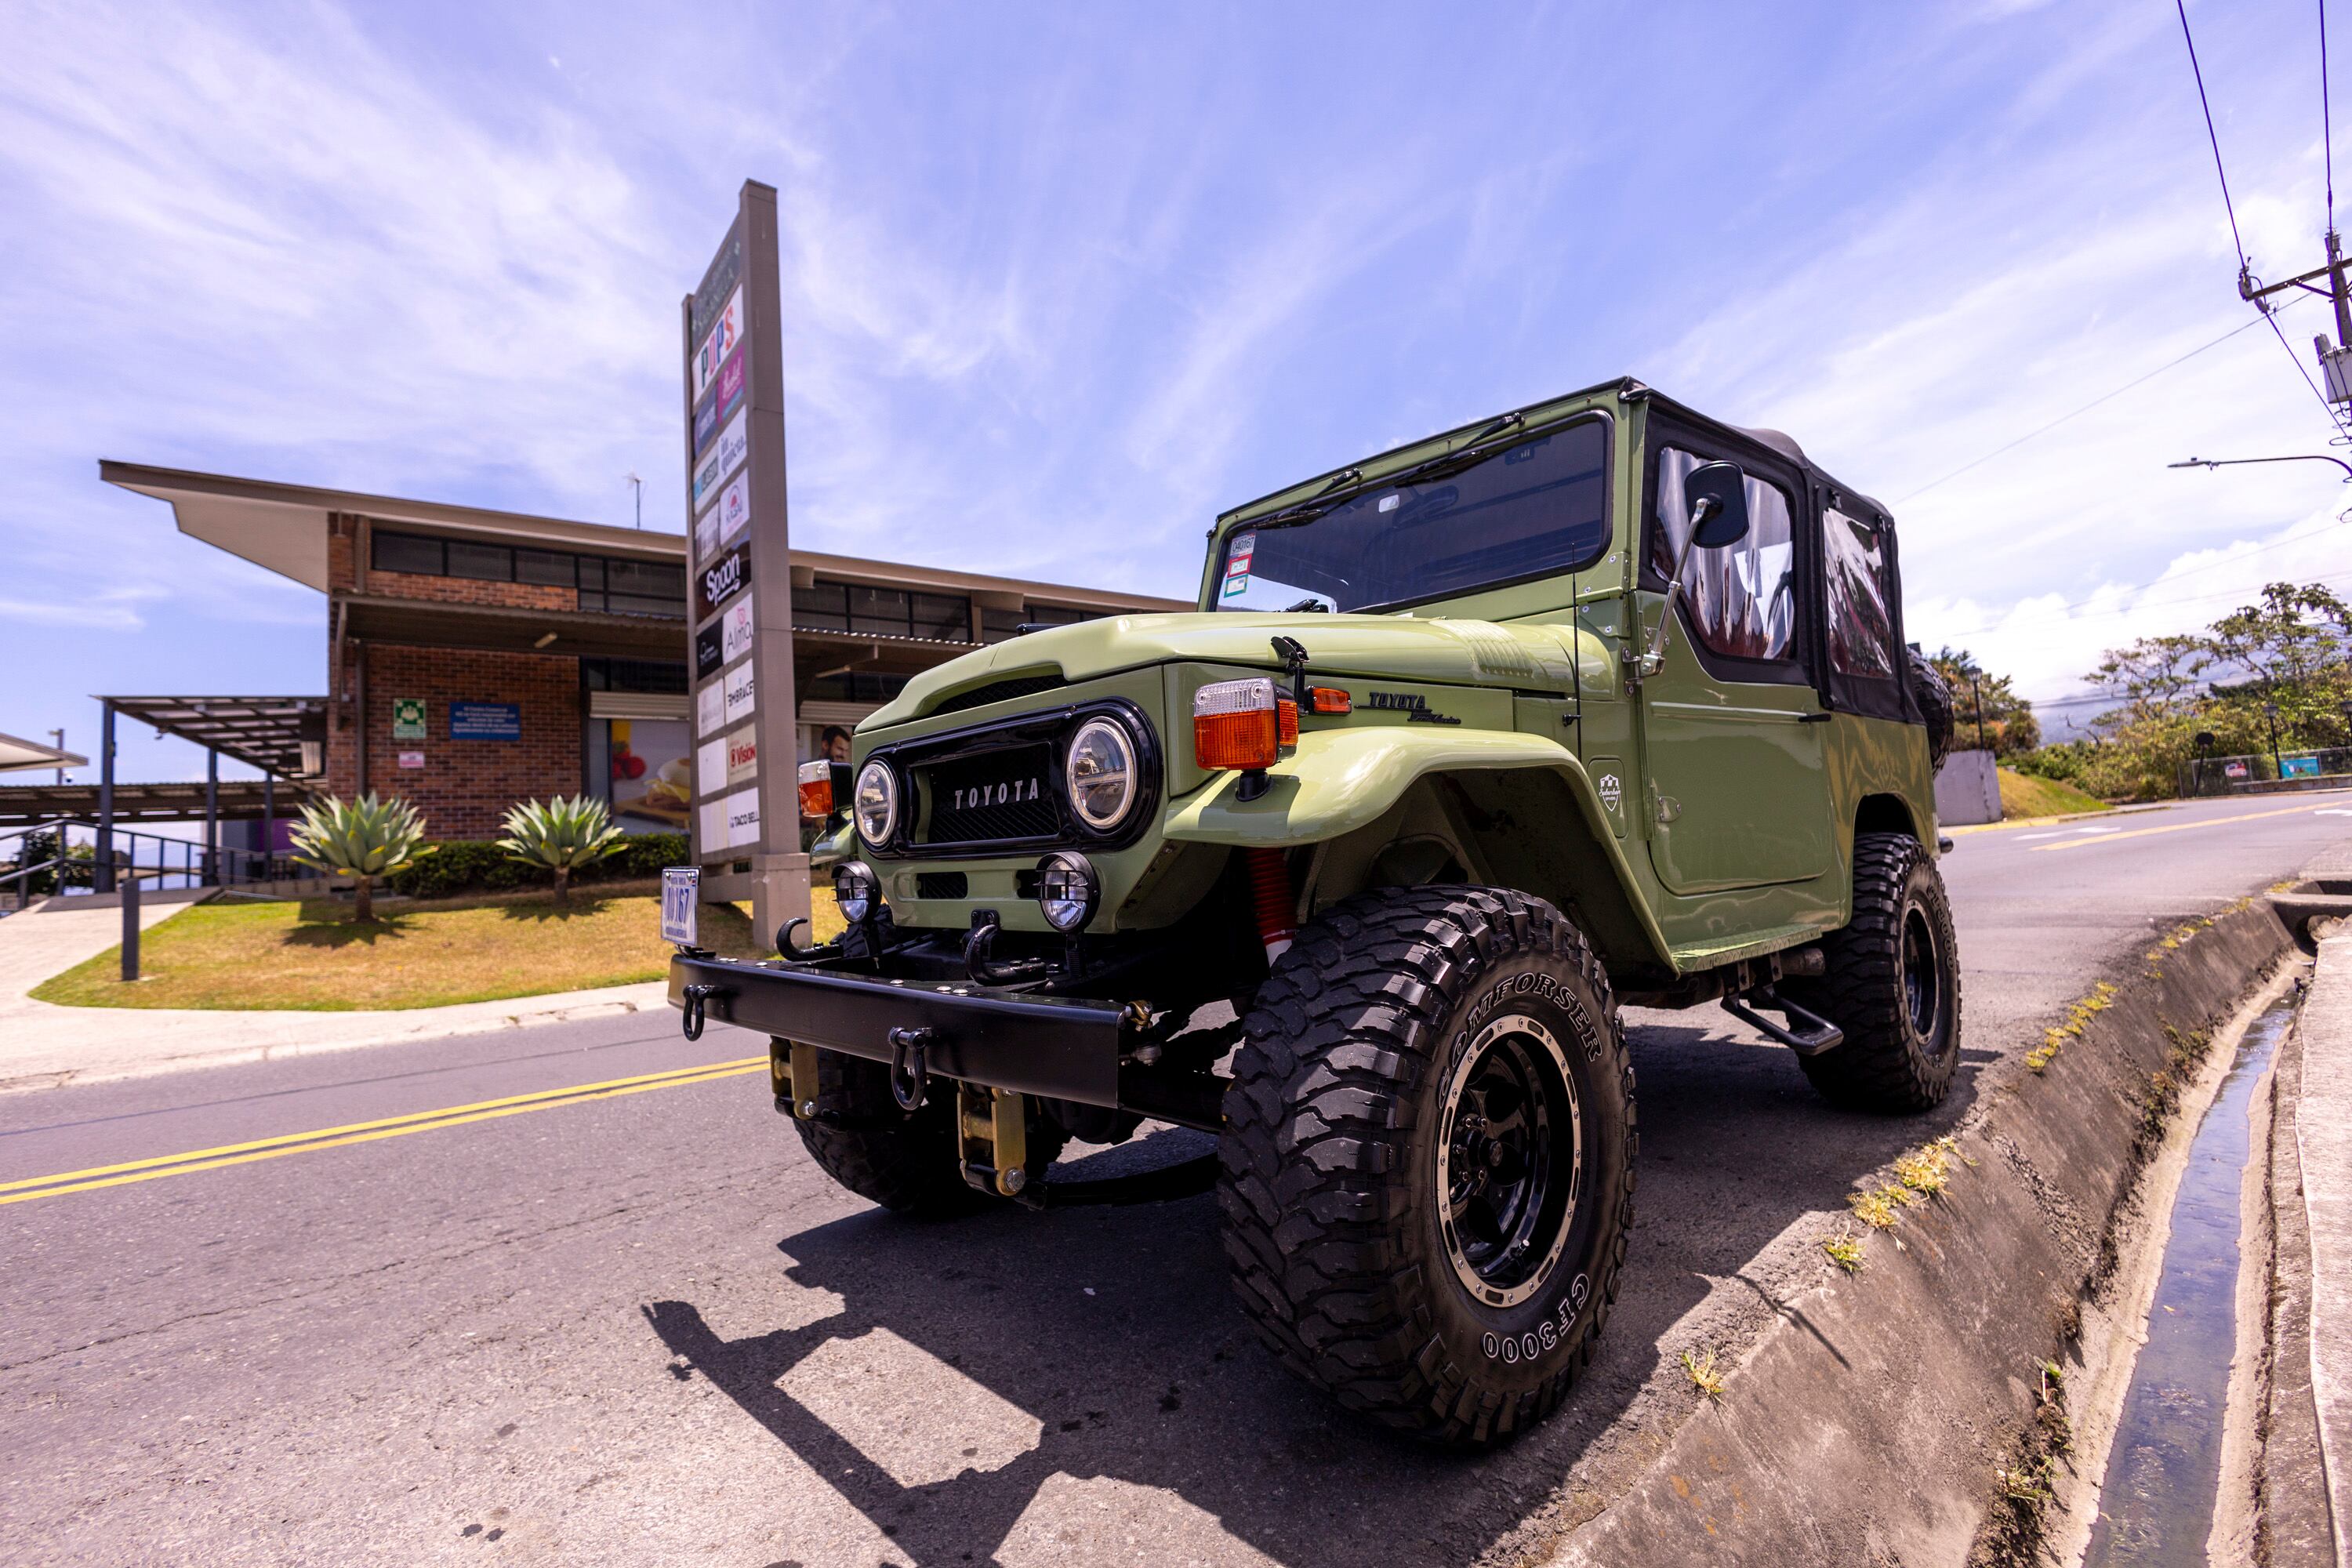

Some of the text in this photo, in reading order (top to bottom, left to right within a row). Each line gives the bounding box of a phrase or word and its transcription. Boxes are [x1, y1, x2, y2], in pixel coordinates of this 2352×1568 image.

[706, 553, 740, 606] Spoon
[1369, 691, 1426, 709] TOYOTA
[955, 778, 1039, 810] TOYOTA
[735, 813, 747, 827] TACO
[1438, 972, 1603, 1109] COMFORSER
[1483, 1273, 1590, 1363] CF3000
